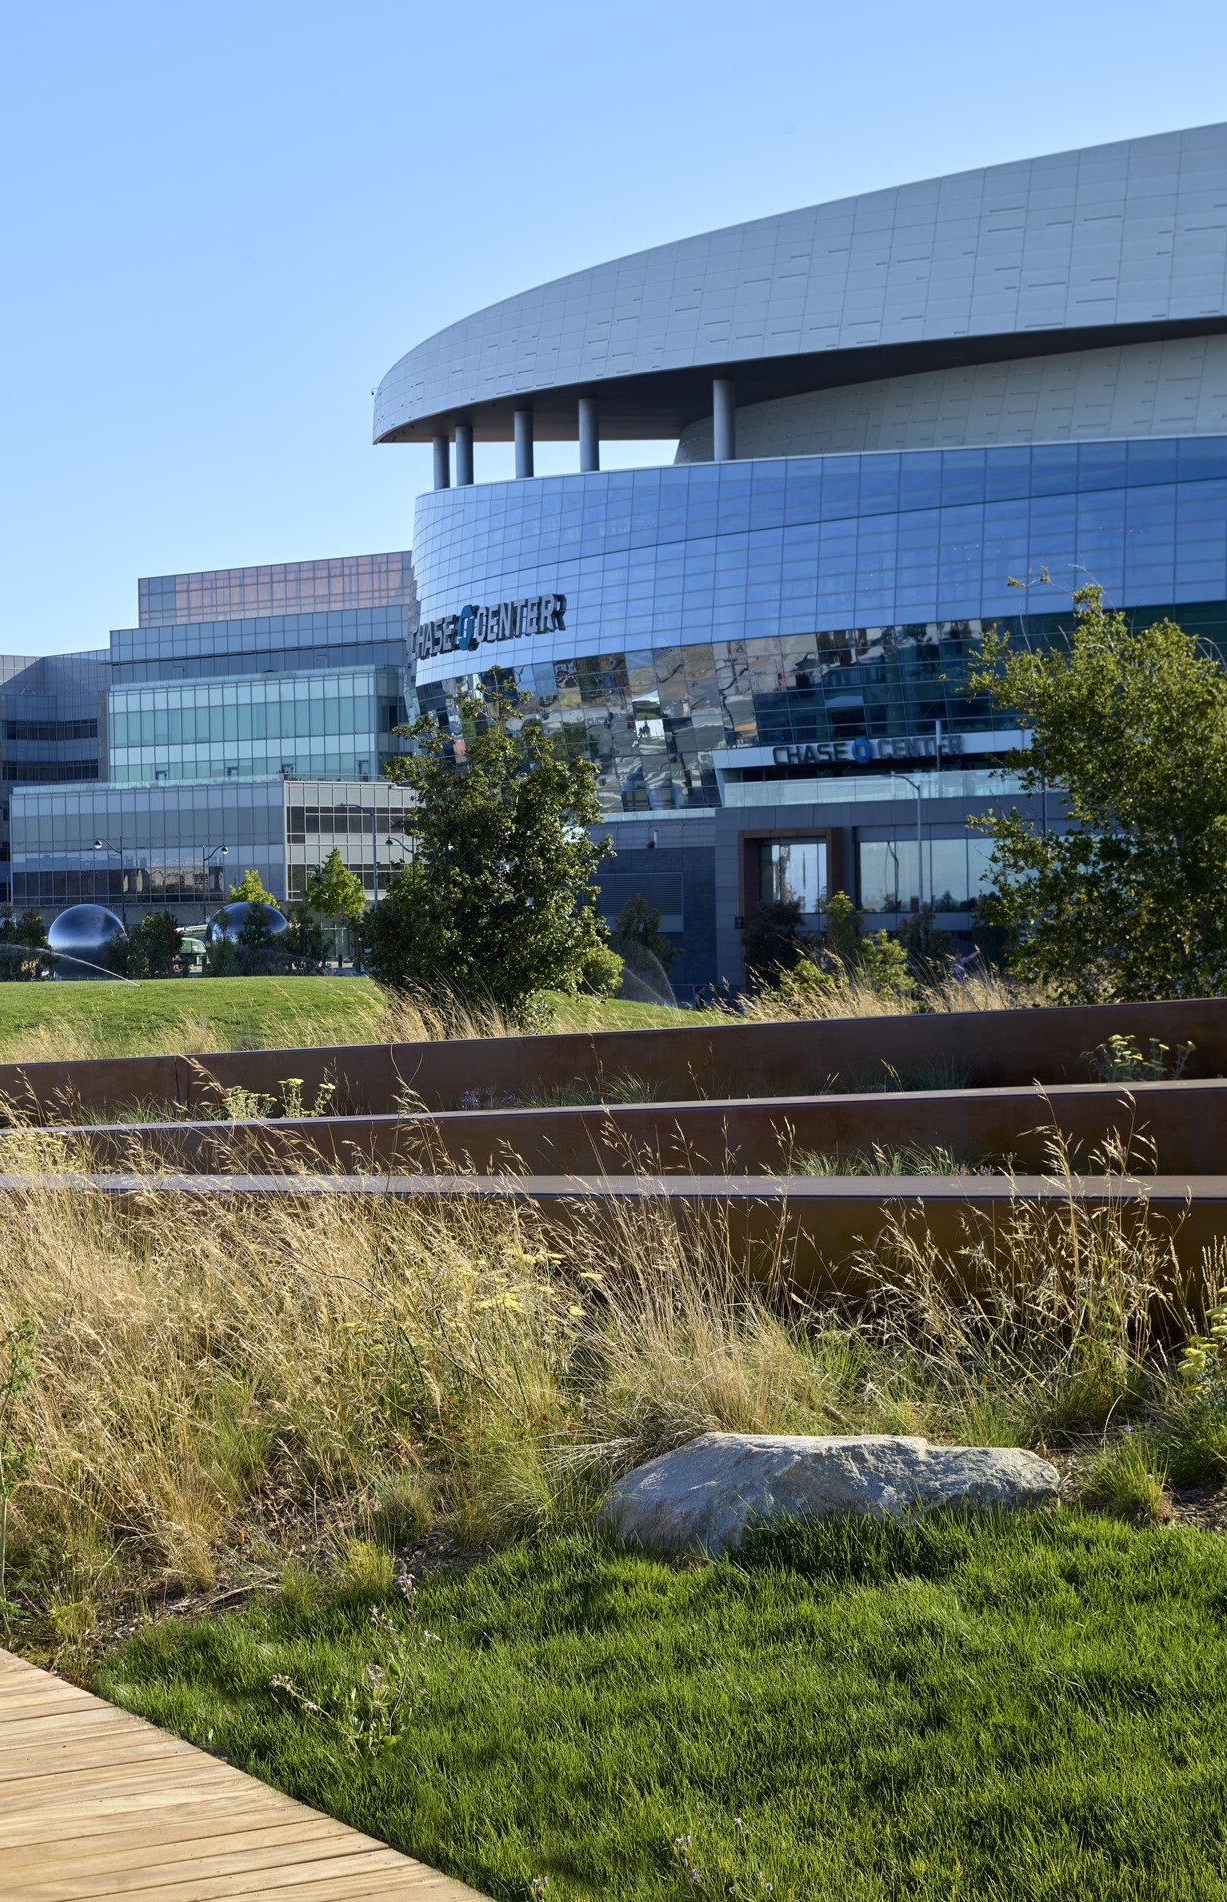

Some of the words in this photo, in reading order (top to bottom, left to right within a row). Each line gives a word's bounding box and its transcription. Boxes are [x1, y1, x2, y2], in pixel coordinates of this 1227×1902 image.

[410, 614, 457, 660] CHASE
[476, 594, 561, 643] CENTER
[772, 743, 850, 765] CHASE
[877, 735, 963, 758] CENTER
